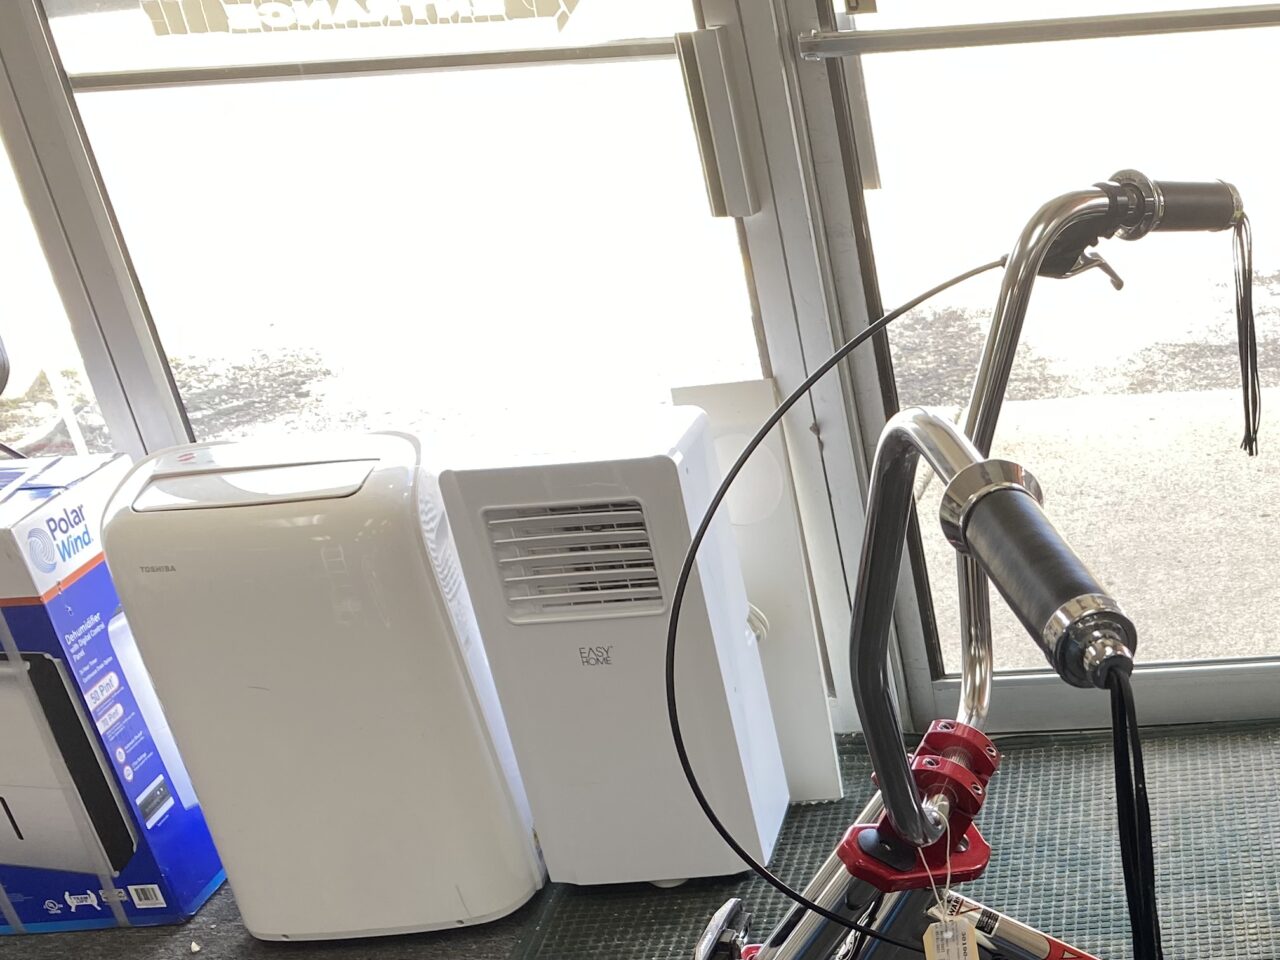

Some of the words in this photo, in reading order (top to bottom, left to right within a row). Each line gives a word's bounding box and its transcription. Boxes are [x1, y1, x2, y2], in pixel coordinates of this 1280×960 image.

[46, 504, 86, 541] Polar
[140, 564, 177, 574] TOSHIBA
[65, 612, 101, 646] Dehumidifier
[579, 646, 611, 659] EASY
[581, 656, 613, 666] HOME
